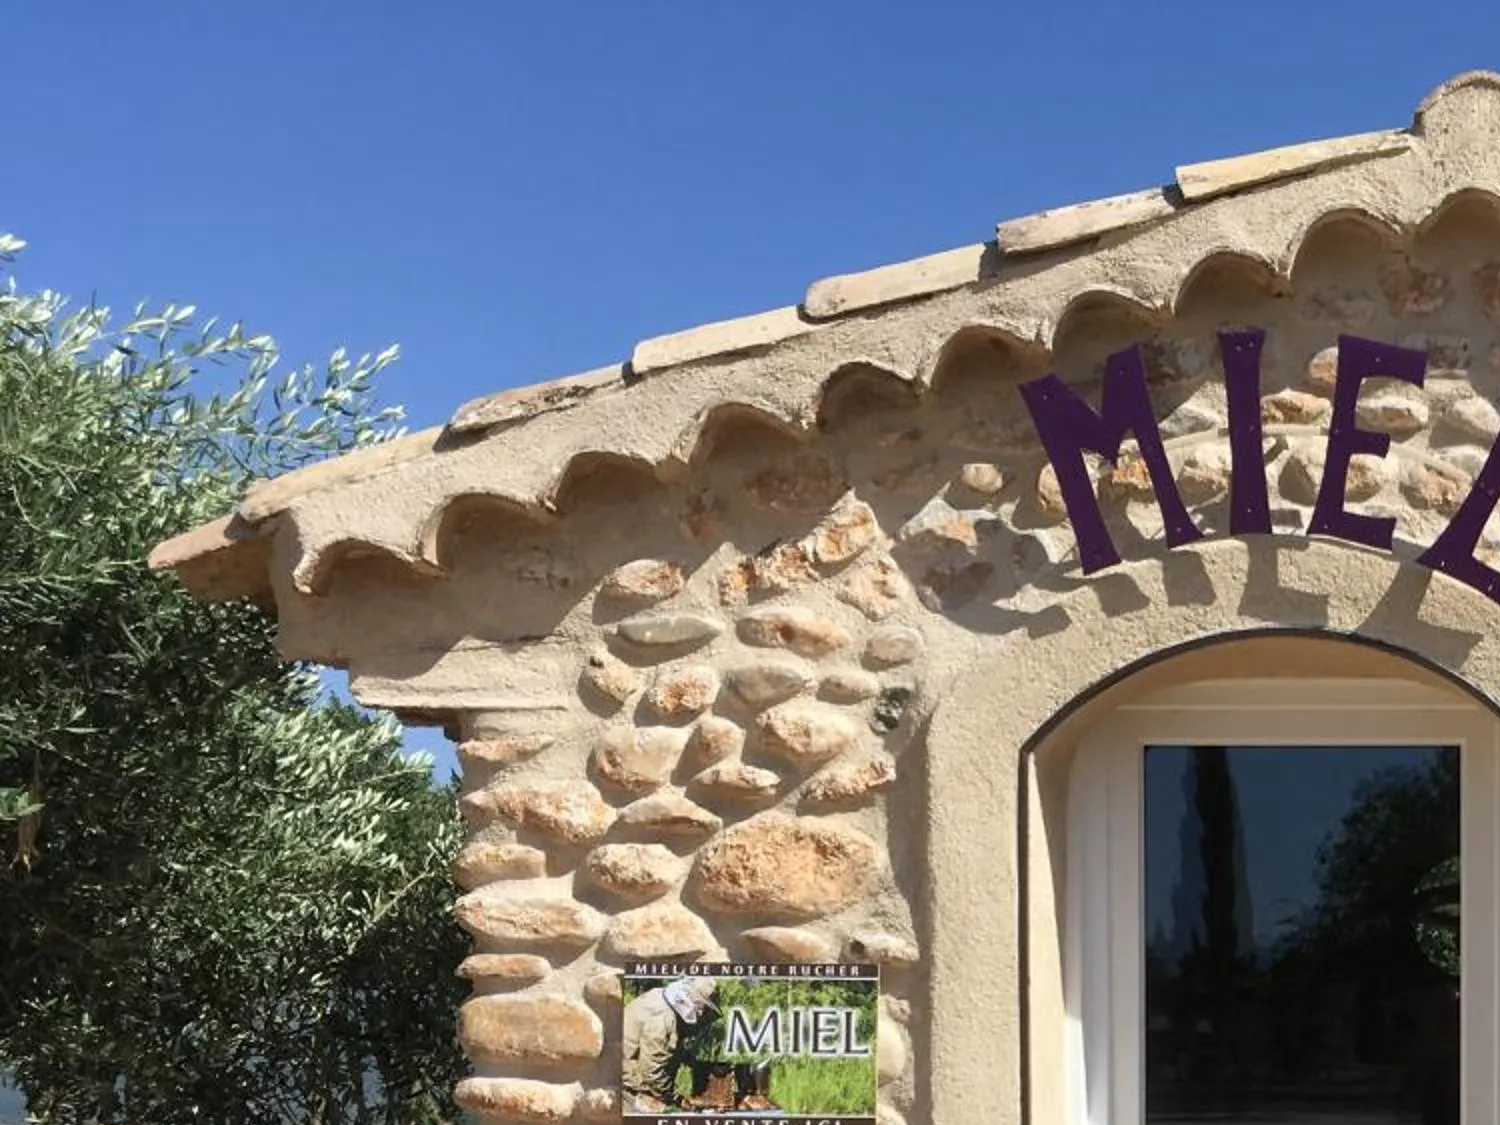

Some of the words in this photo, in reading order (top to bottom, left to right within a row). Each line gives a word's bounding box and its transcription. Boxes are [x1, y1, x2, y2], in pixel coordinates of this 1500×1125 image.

[635, 963, 679, 975] MIEL
[690, 964, 711, 976] DE
[721, 964, 778, 976] NOTRE
[788, 965, 860, 976] RUCHER
[726, 1008, 870, 1055] MIEL
